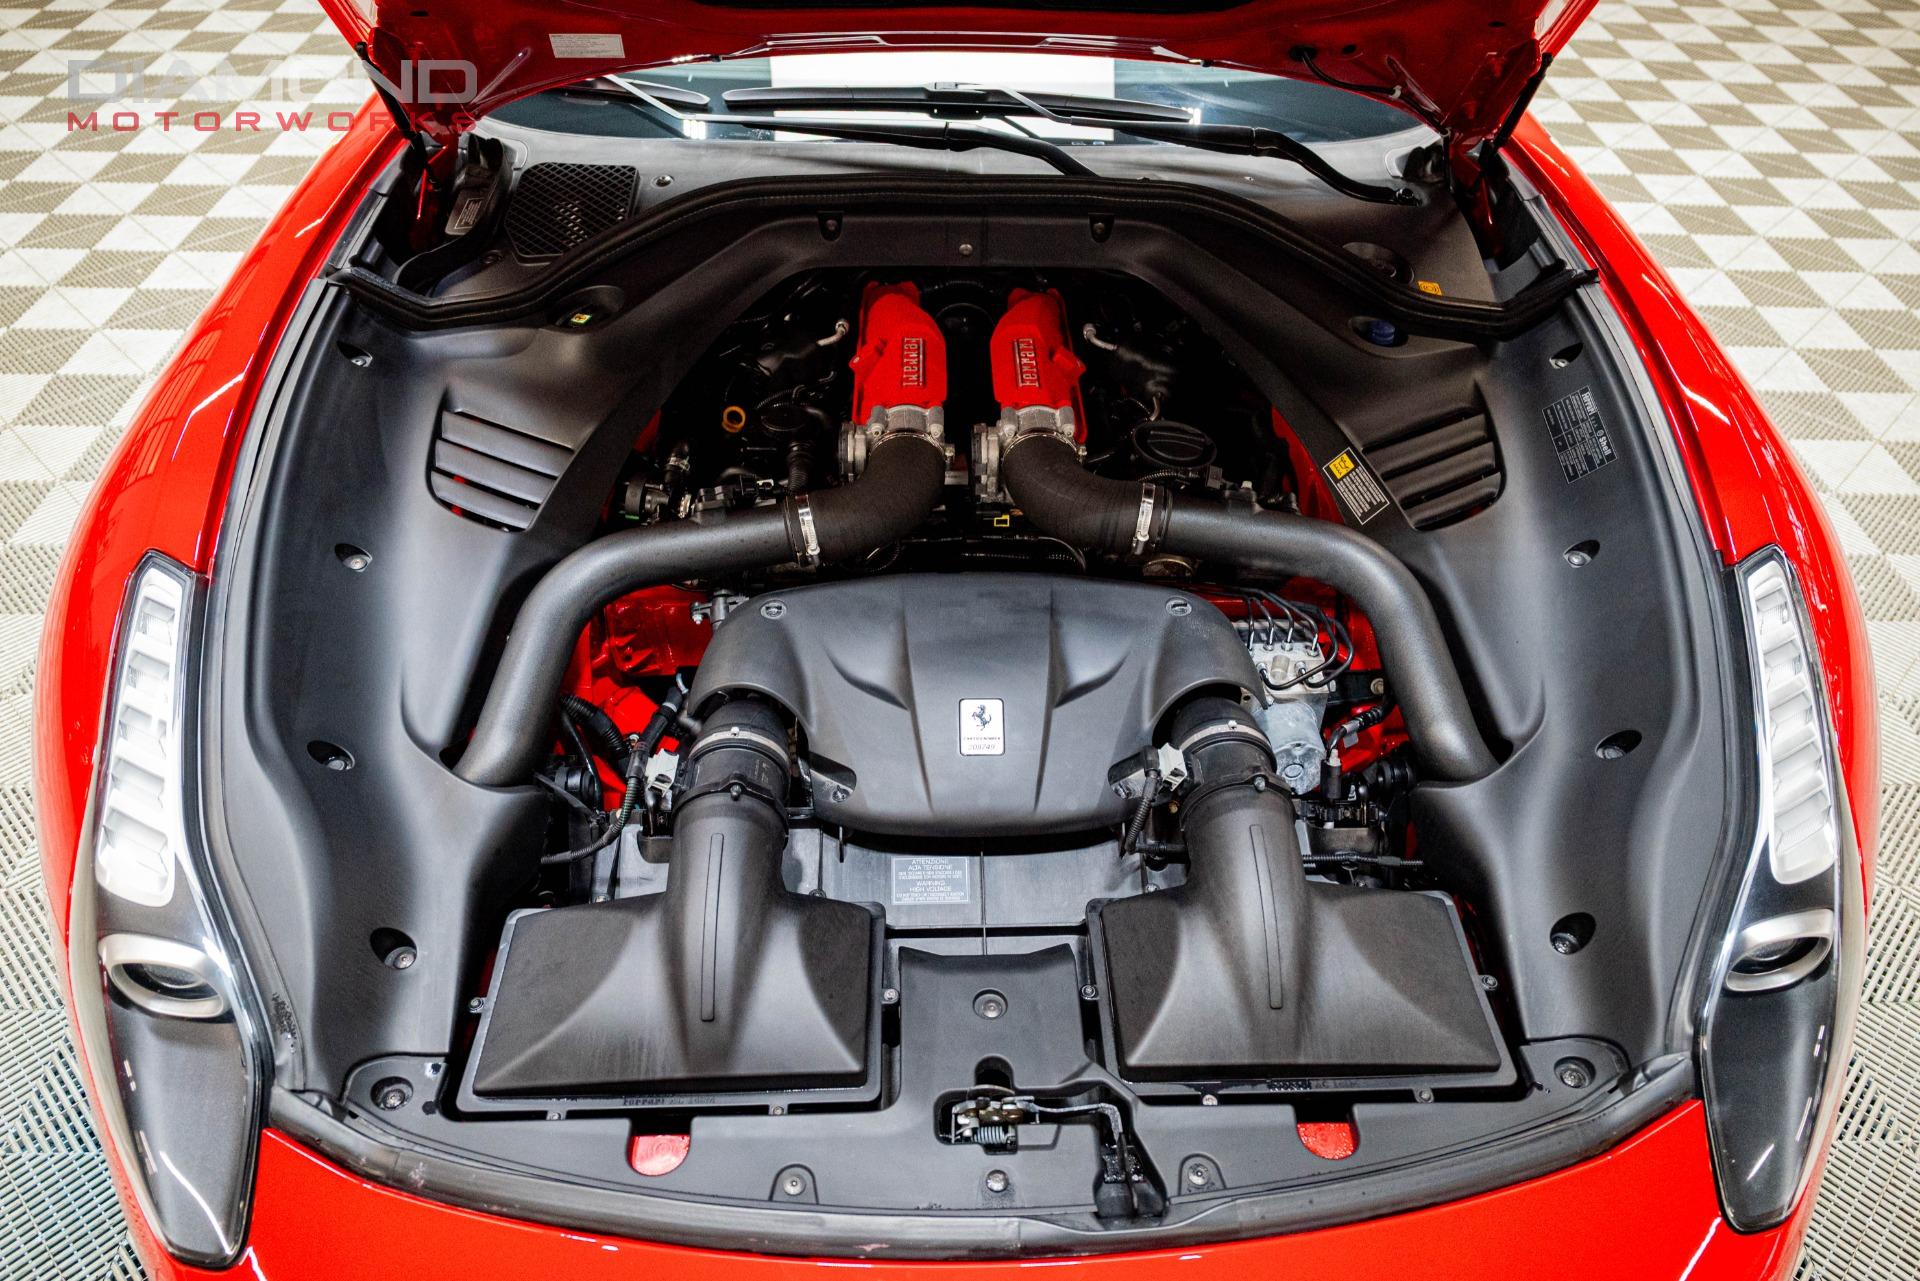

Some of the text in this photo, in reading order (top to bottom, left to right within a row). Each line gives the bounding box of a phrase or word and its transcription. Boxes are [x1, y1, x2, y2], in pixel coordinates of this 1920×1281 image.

[902, 337, 924, 387] Ferrari
[1013, 337, 1040, 388] Ferrari
[1599, 436, 1612, 456] Shell
